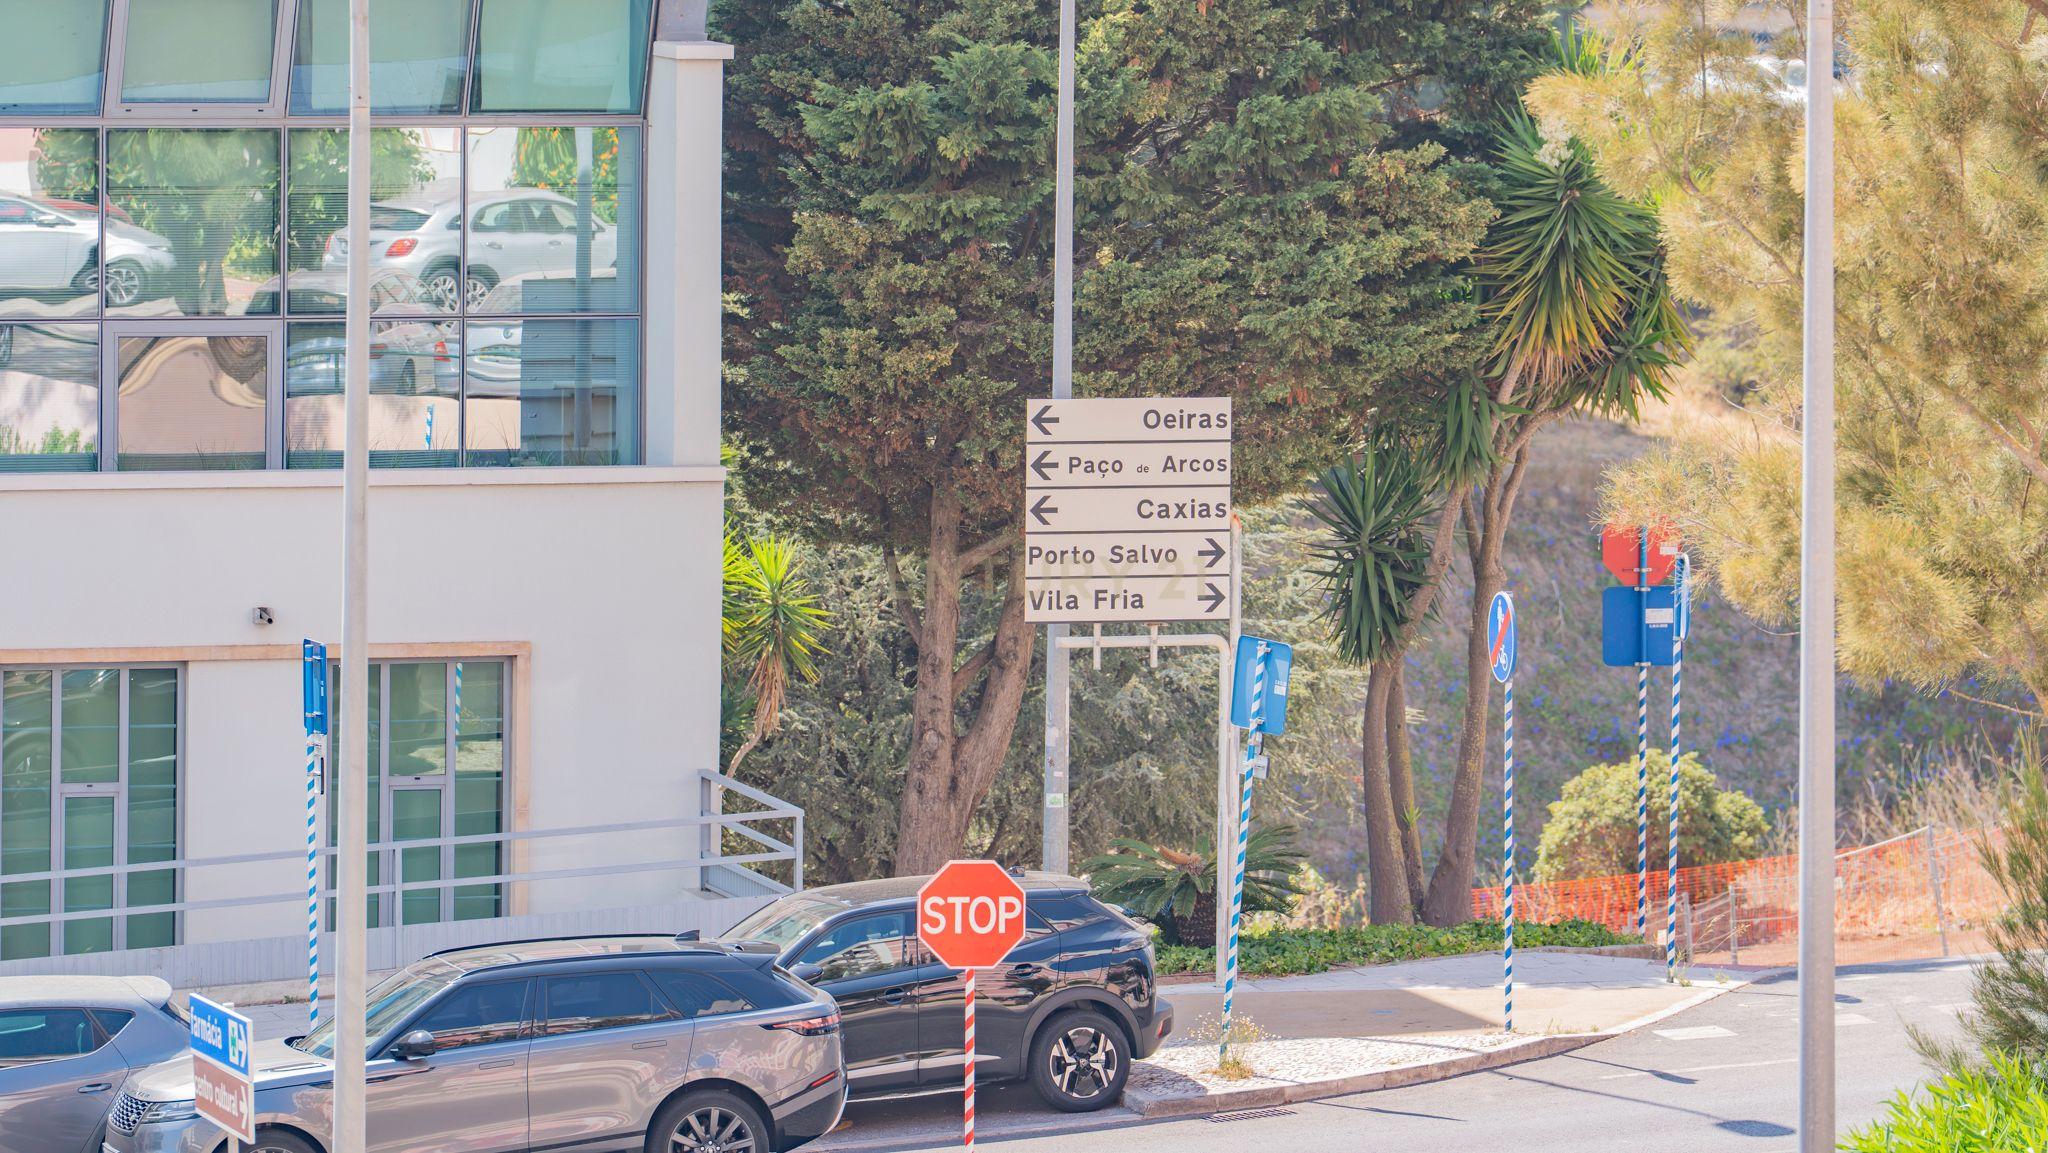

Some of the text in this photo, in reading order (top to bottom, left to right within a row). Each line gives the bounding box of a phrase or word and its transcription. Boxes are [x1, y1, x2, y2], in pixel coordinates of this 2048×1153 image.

[1143, 408, 1228, 430] Oeiras
[1068, 455, 1228, 479] Paço de Arcos
[1136, 498, 1227, 519] Caxias
[1028, 544, 1178, 566] Porto Salvo
[1029, 589, 1145, 611] Vila Fria
[922, 896, 1022, 935] STOP
[190, 1006, 223, 1050] farmácia
[214, 1081, 239, 1118] cultural
